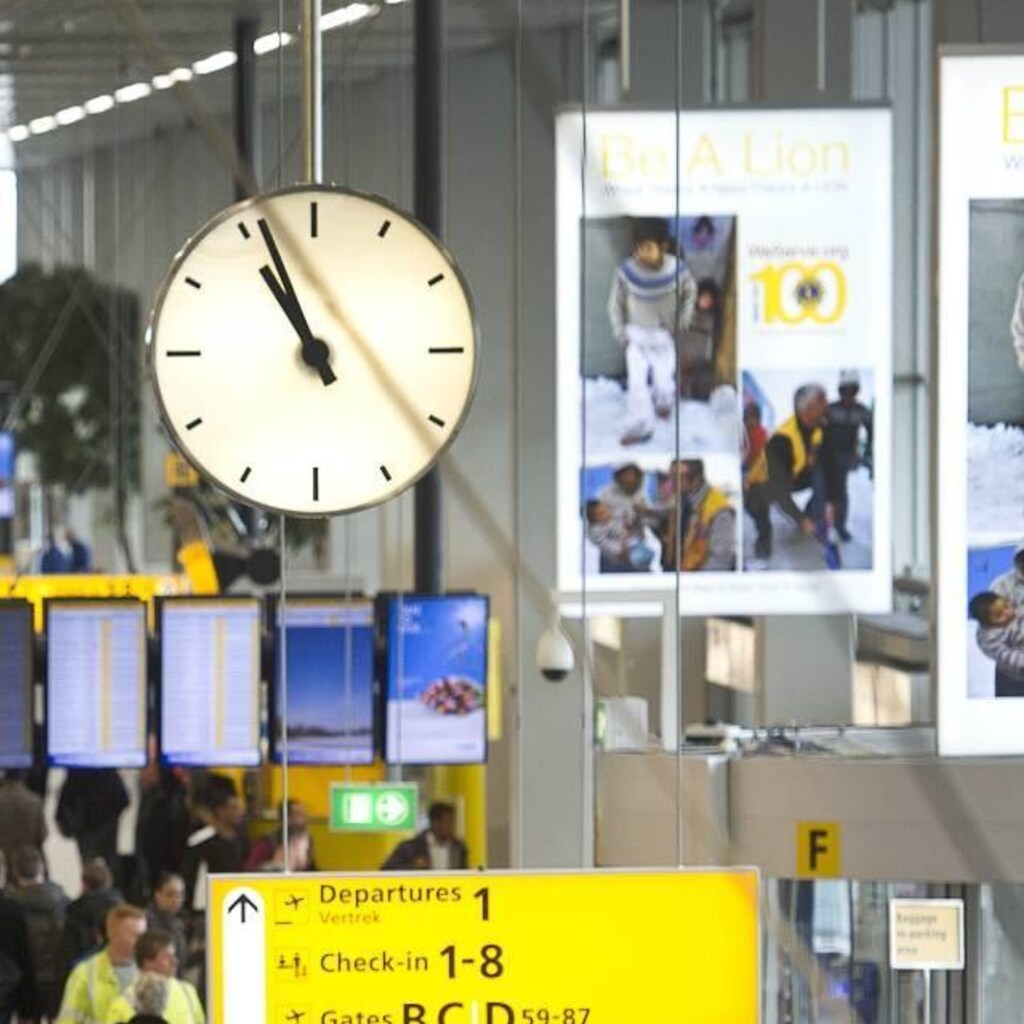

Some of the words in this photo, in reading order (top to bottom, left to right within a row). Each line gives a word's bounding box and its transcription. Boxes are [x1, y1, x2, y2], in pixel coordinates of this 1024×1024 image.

[688, 132, 724, 177] A
[743, 128, 851, 179] Lion
[808, 829, 829, 871] F
[319, 884, 462, 906] Departures
[472, 887, 491, 922] 1
[320, 911, 381, 924] Vertrek
[319, 950, 429, 974] Check-in
[439, 943, 505, 980] 1-8
